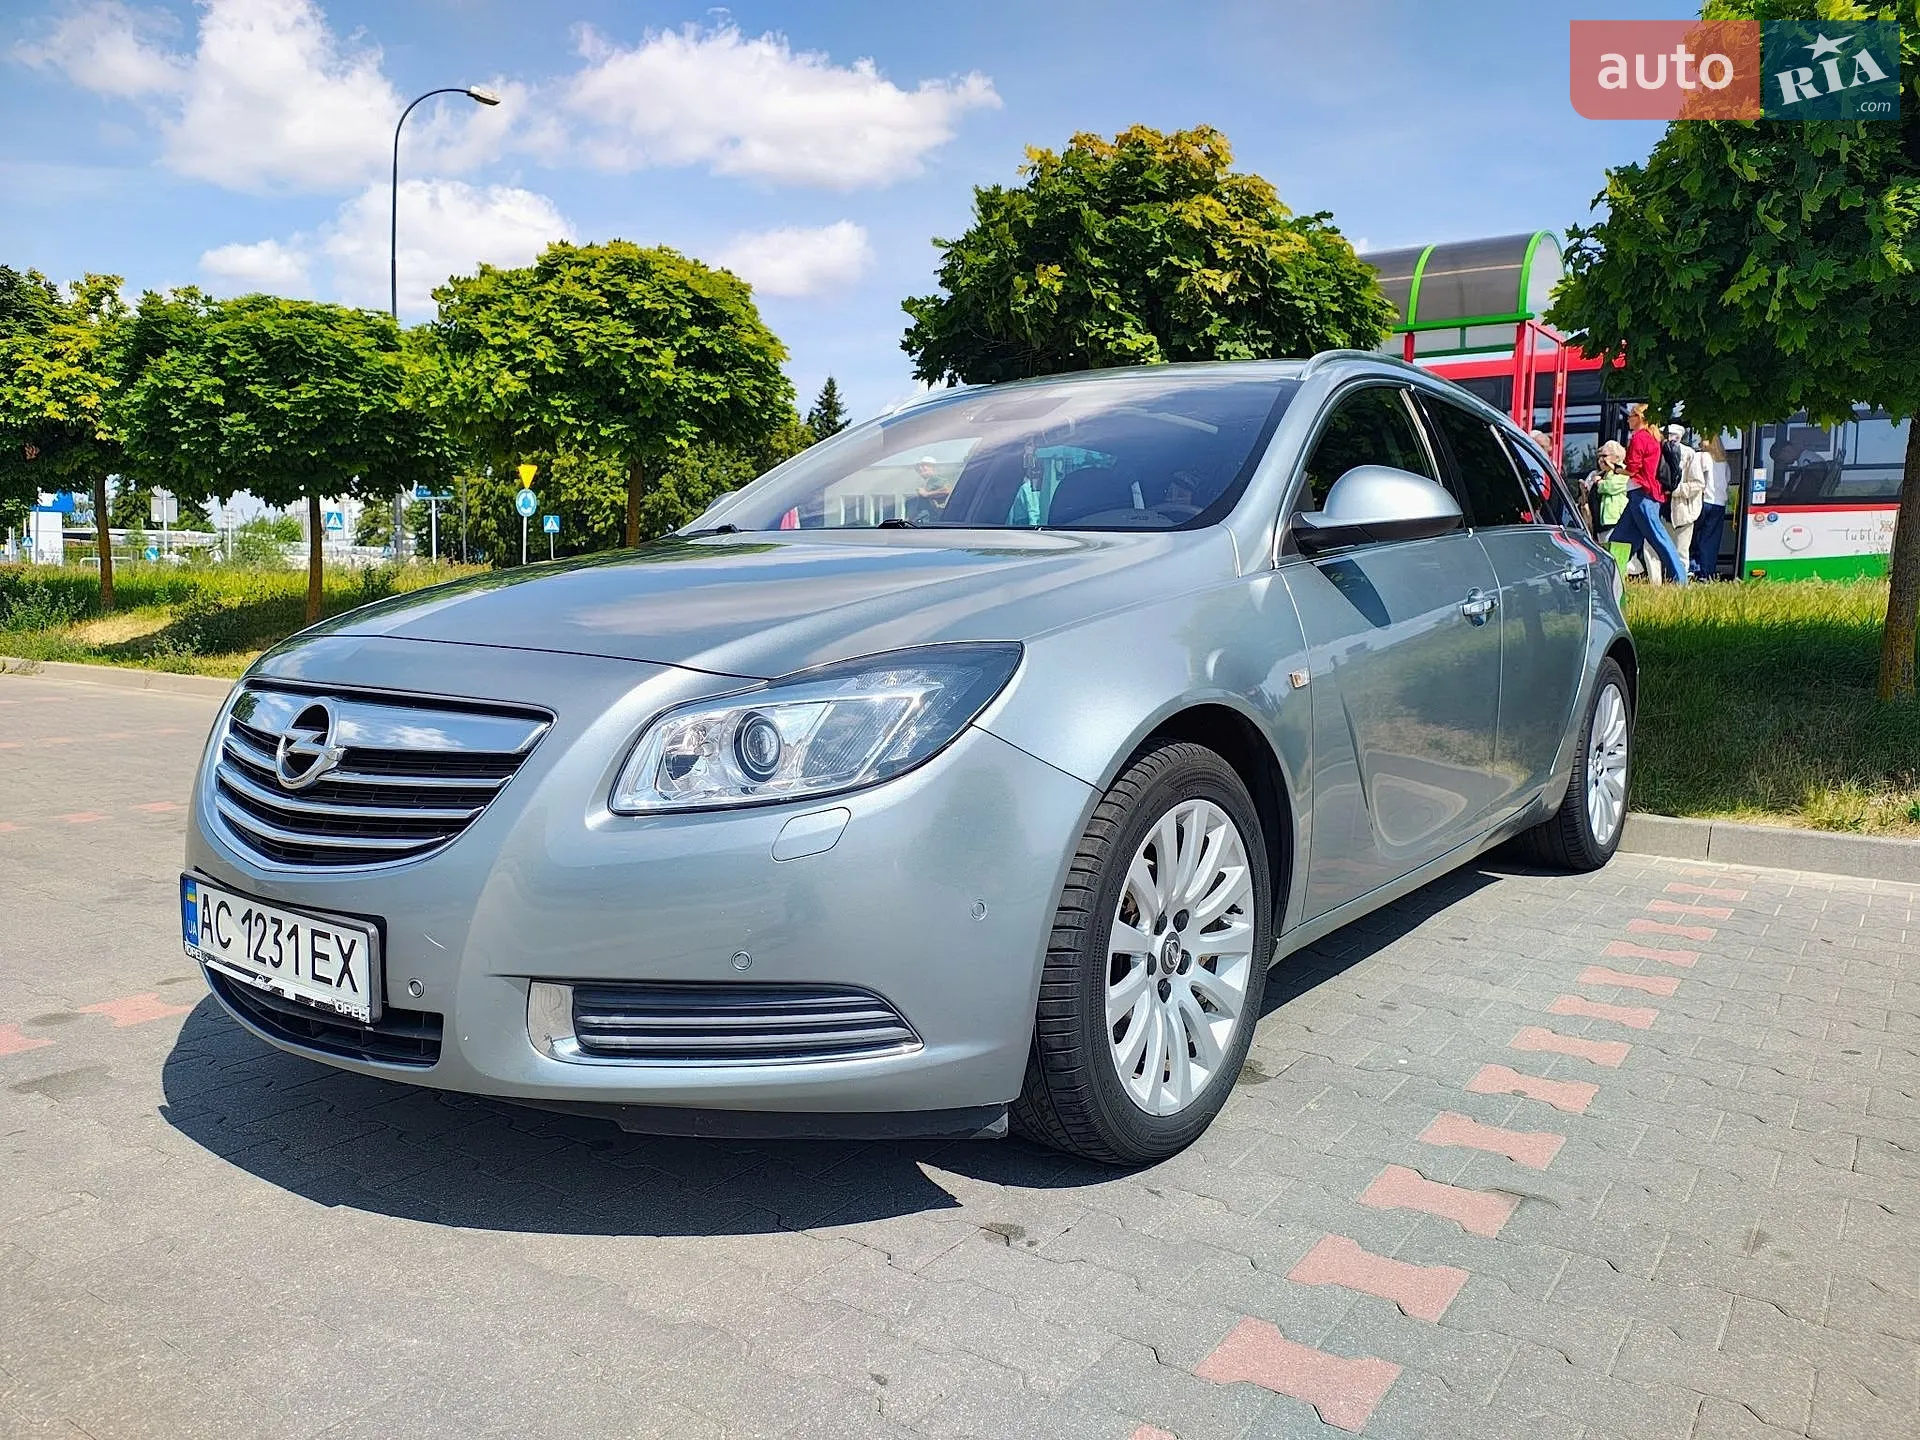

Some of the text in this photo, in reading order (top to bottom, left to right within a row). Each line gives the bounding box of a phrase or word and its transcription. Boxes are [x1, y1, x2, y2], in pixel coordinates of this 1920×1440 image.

[188, 920, 198, 936] UA
[201, 893, 358, 993] AC 1231 EX
